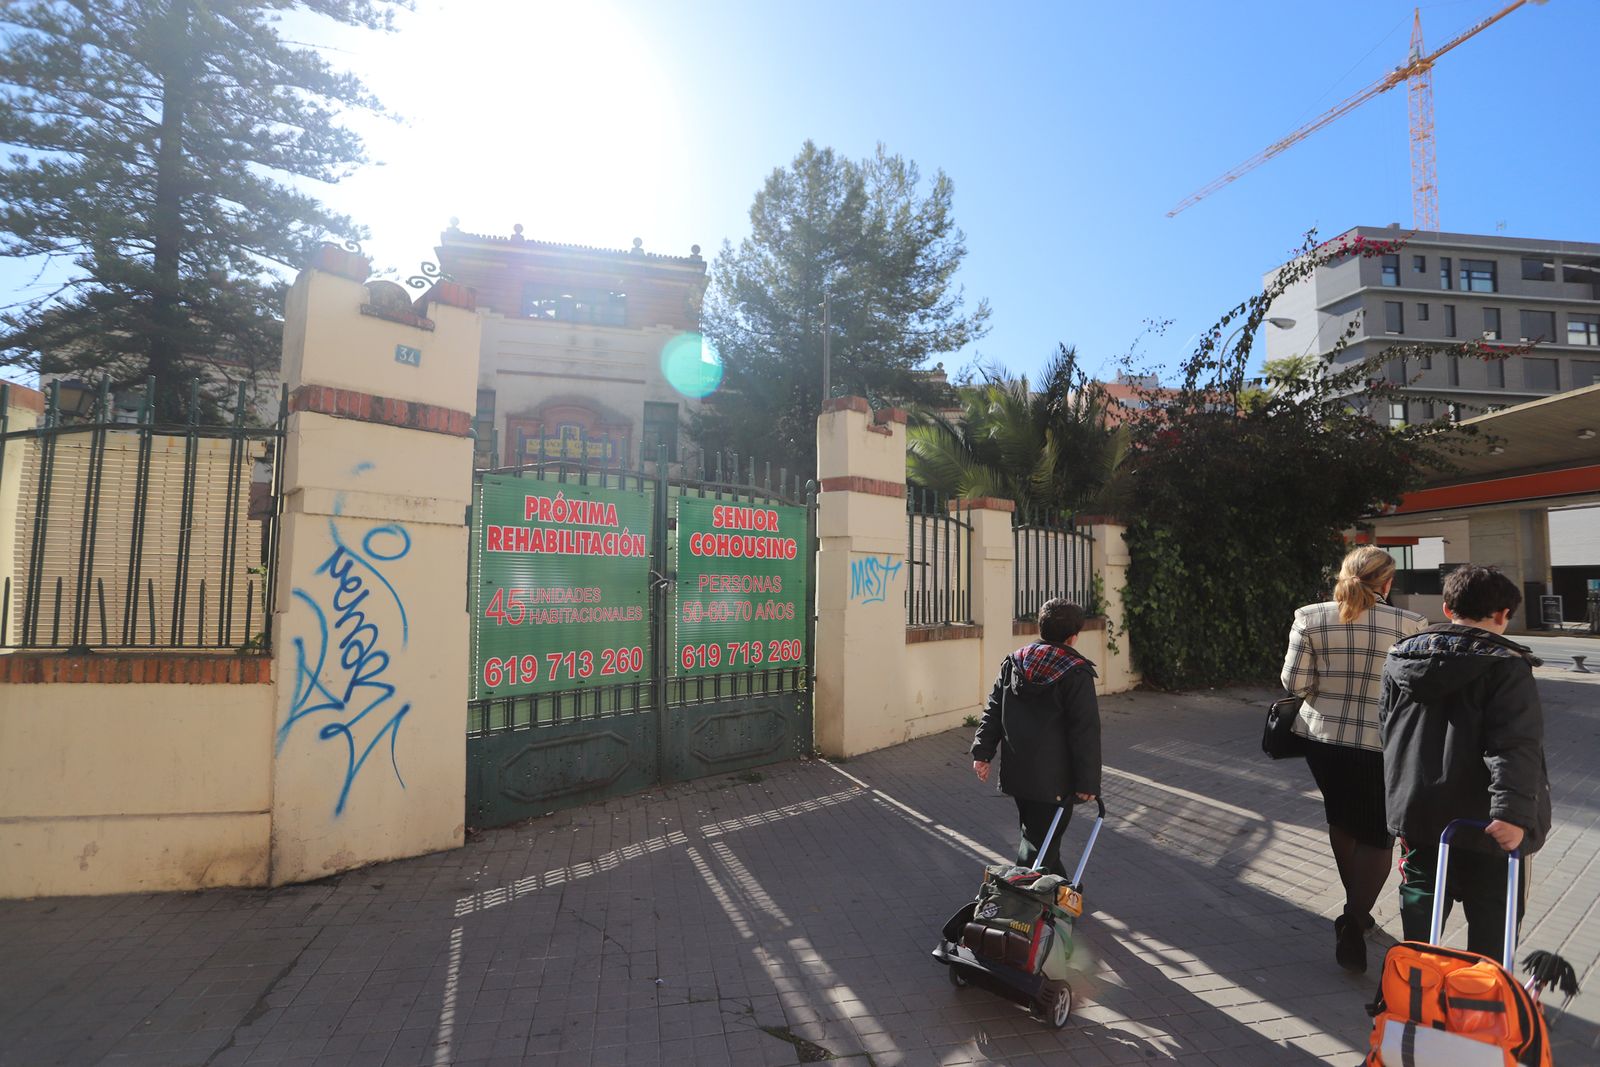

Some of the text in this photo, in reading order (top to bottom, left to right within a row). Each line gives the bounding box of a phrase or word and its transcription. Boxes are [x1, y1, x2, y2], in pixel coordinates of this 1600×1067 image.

[525, 490, 618, 527] PRÓXIMA
[712, 505, 779, 532] SENIOR
[487, 525, 645, 557] REHABILITACIÓN
[690, 532, 797, 560] COHOUSING
[699, 574, 782, 593] PERSONAS
[485, 588, 601, 625] 45 UNIDADES
[529, 606, 643, 624] HABITACIONALES
[683, 599, 795, 623] 50-60-70 AÑOS
[484, 646, 643, 688] 619 713 260
[681, 639, 801, 669] 619 713 260
